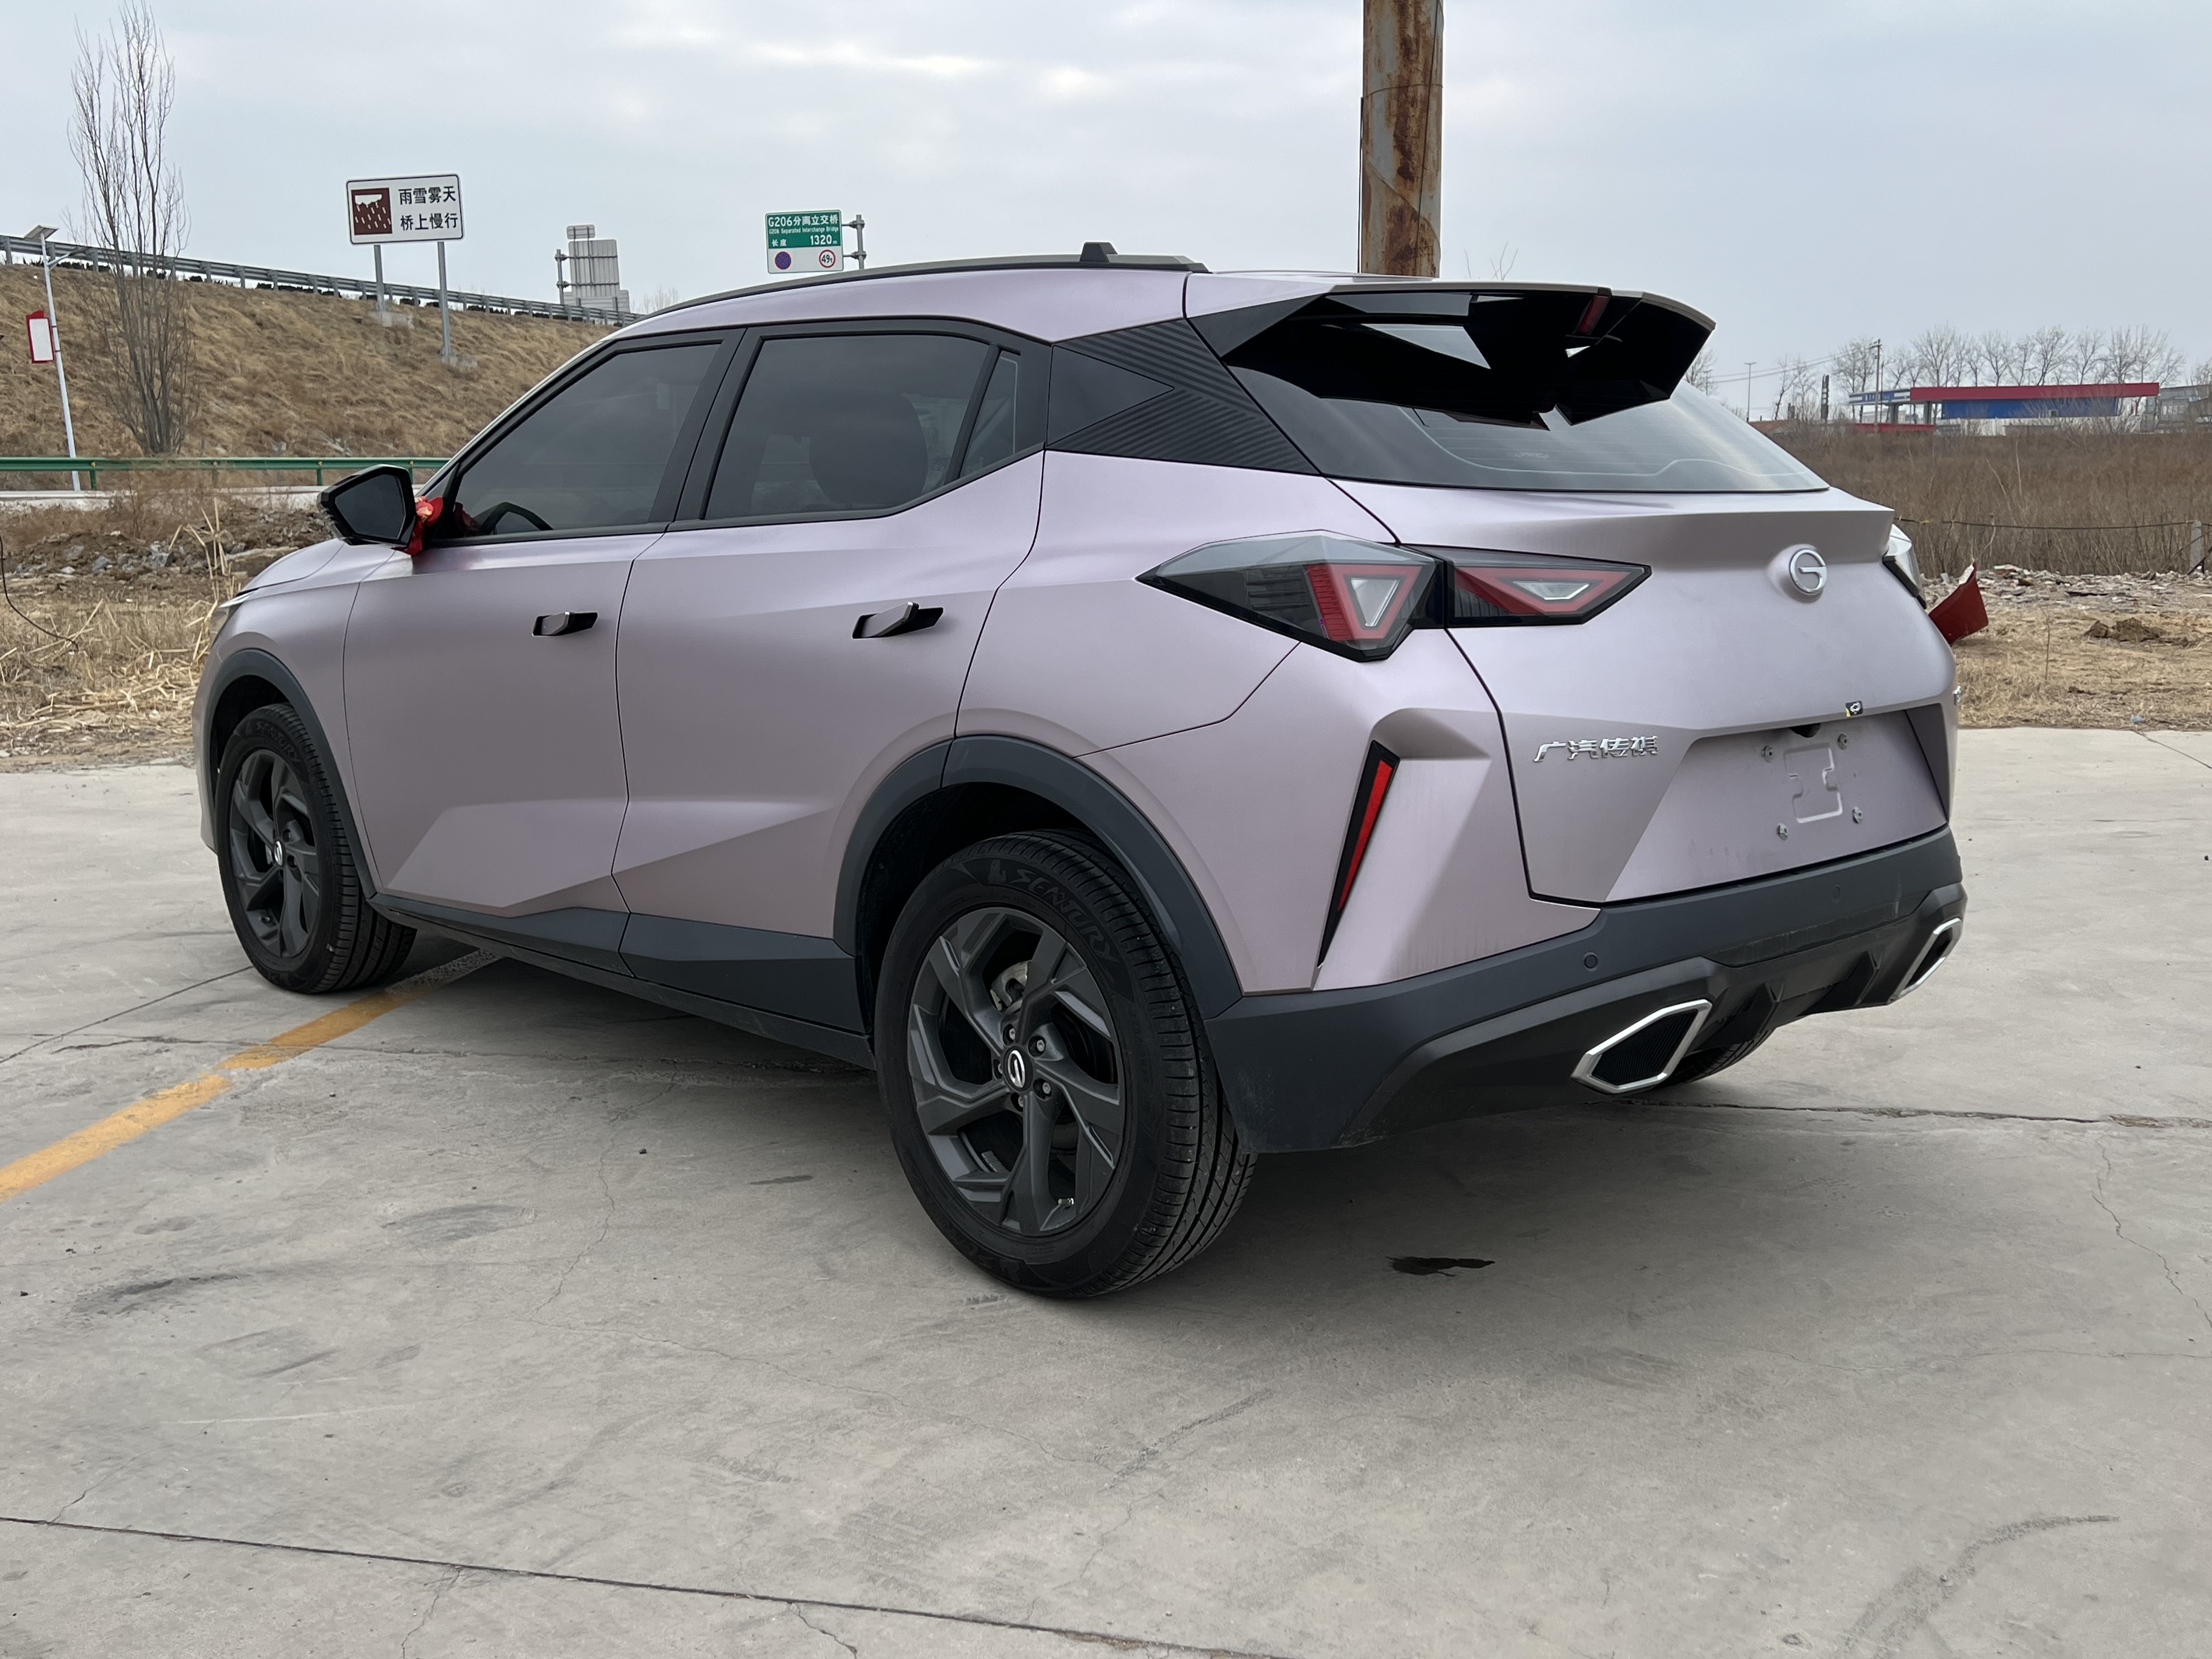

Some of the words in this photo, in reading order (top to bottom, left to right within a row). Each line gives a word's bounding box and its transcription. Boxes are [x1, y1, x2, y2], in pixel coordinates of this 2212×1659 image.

[398, 185, 456, 205] 雨雪雾天
[400, 212, 459, 231] 桥上慢行
[771, 239, 787, 247] 长度
[1533, 736, 1658, 762] 广汽传祺
[1009, 868, 1121, 963] SENTURY
